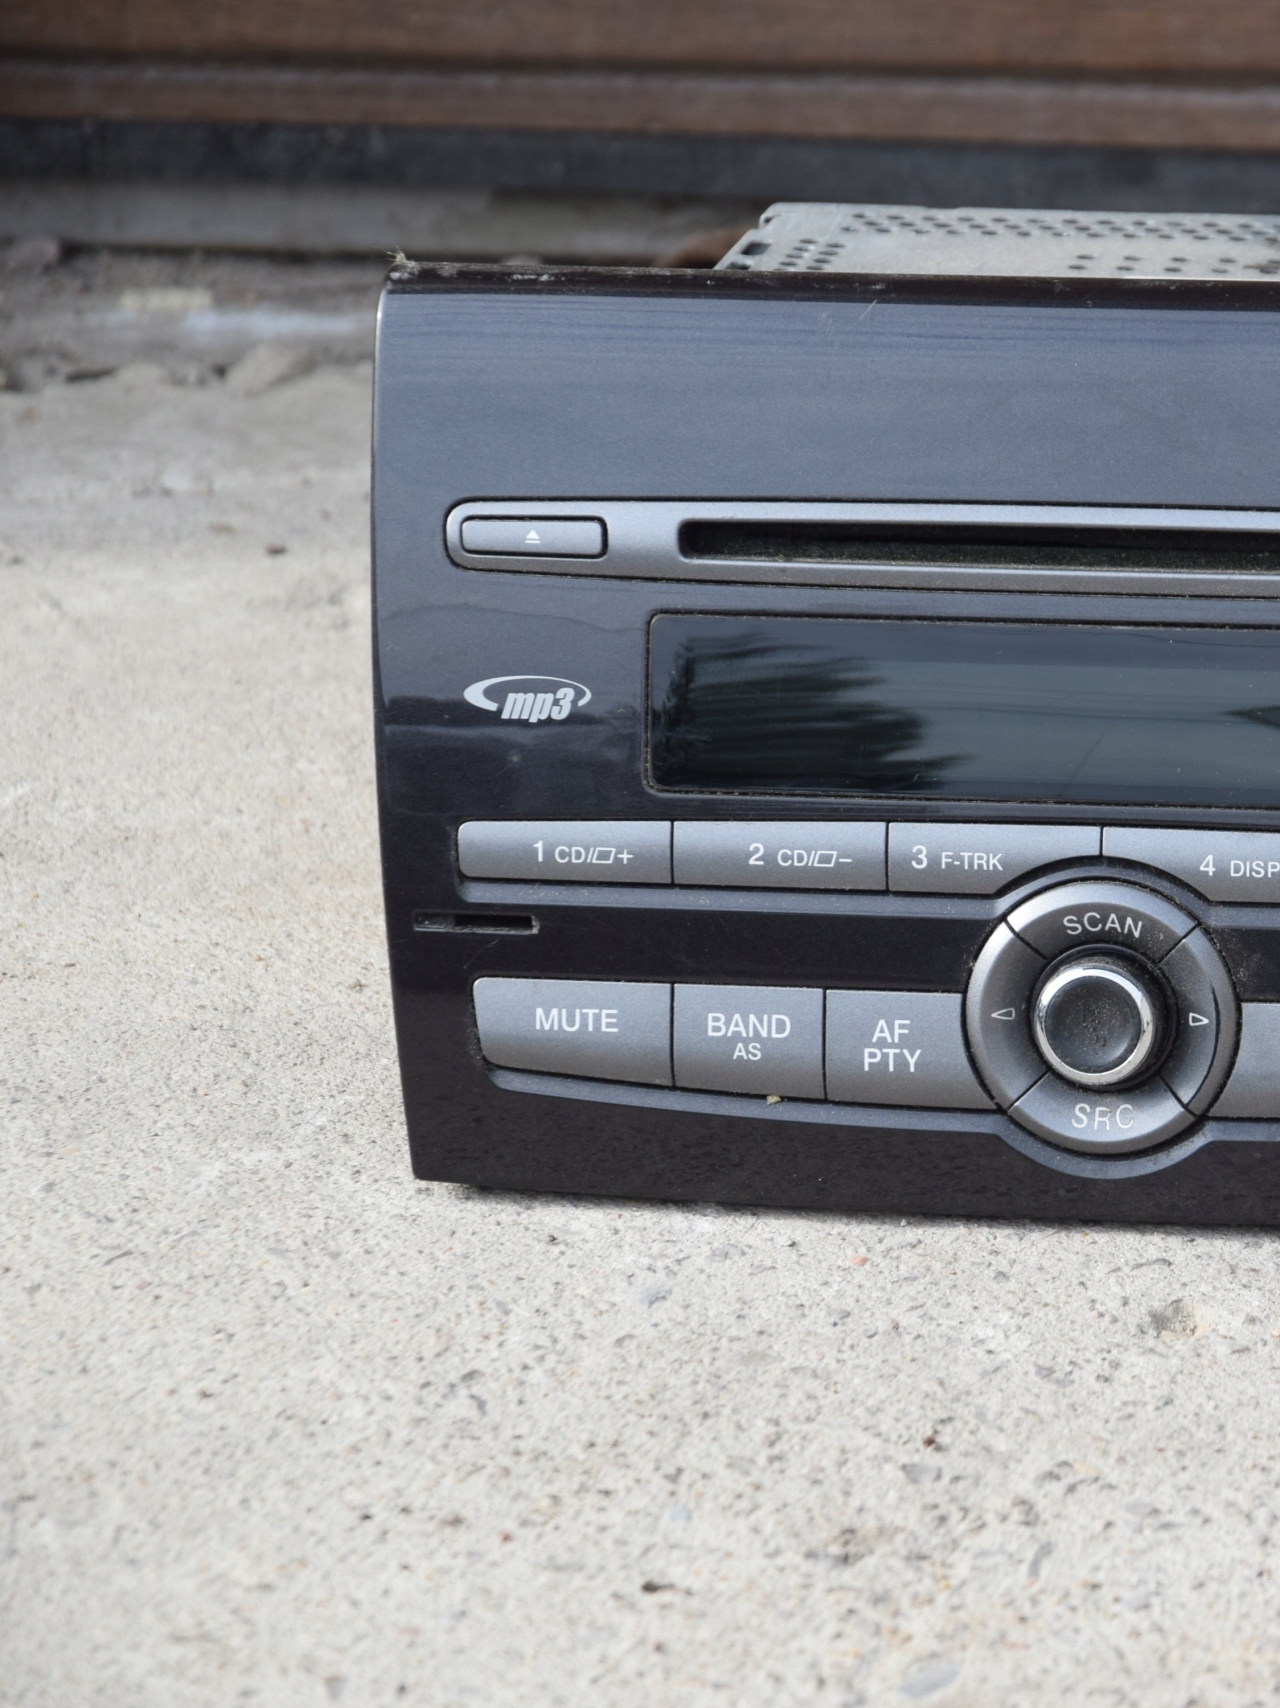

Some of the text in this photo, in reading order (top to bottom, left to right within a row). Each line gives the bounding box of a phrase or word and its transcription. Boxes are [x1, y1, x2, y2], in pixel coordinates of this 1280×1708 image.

[500, 687, 576, 723] mp3
[533, 840, 544, 863] 1
[748, 842, 765, 866] 2
[911, 845, 1004, 871] 3 F-TRK
[1199, 854, 1280, 879] 4 DISP
[1063, 912, 1142, 938] SCAN
[535, 1007, 619, 1033] MUTE
[707, 1012, 791, 1039] BAND
[871, 1018, 911, 1044] AF
[732, 1042, 762, 1061] AS
[863, 1047, 922, 1073] PTY
[1071, 1103, 1134, 1131] SRC
